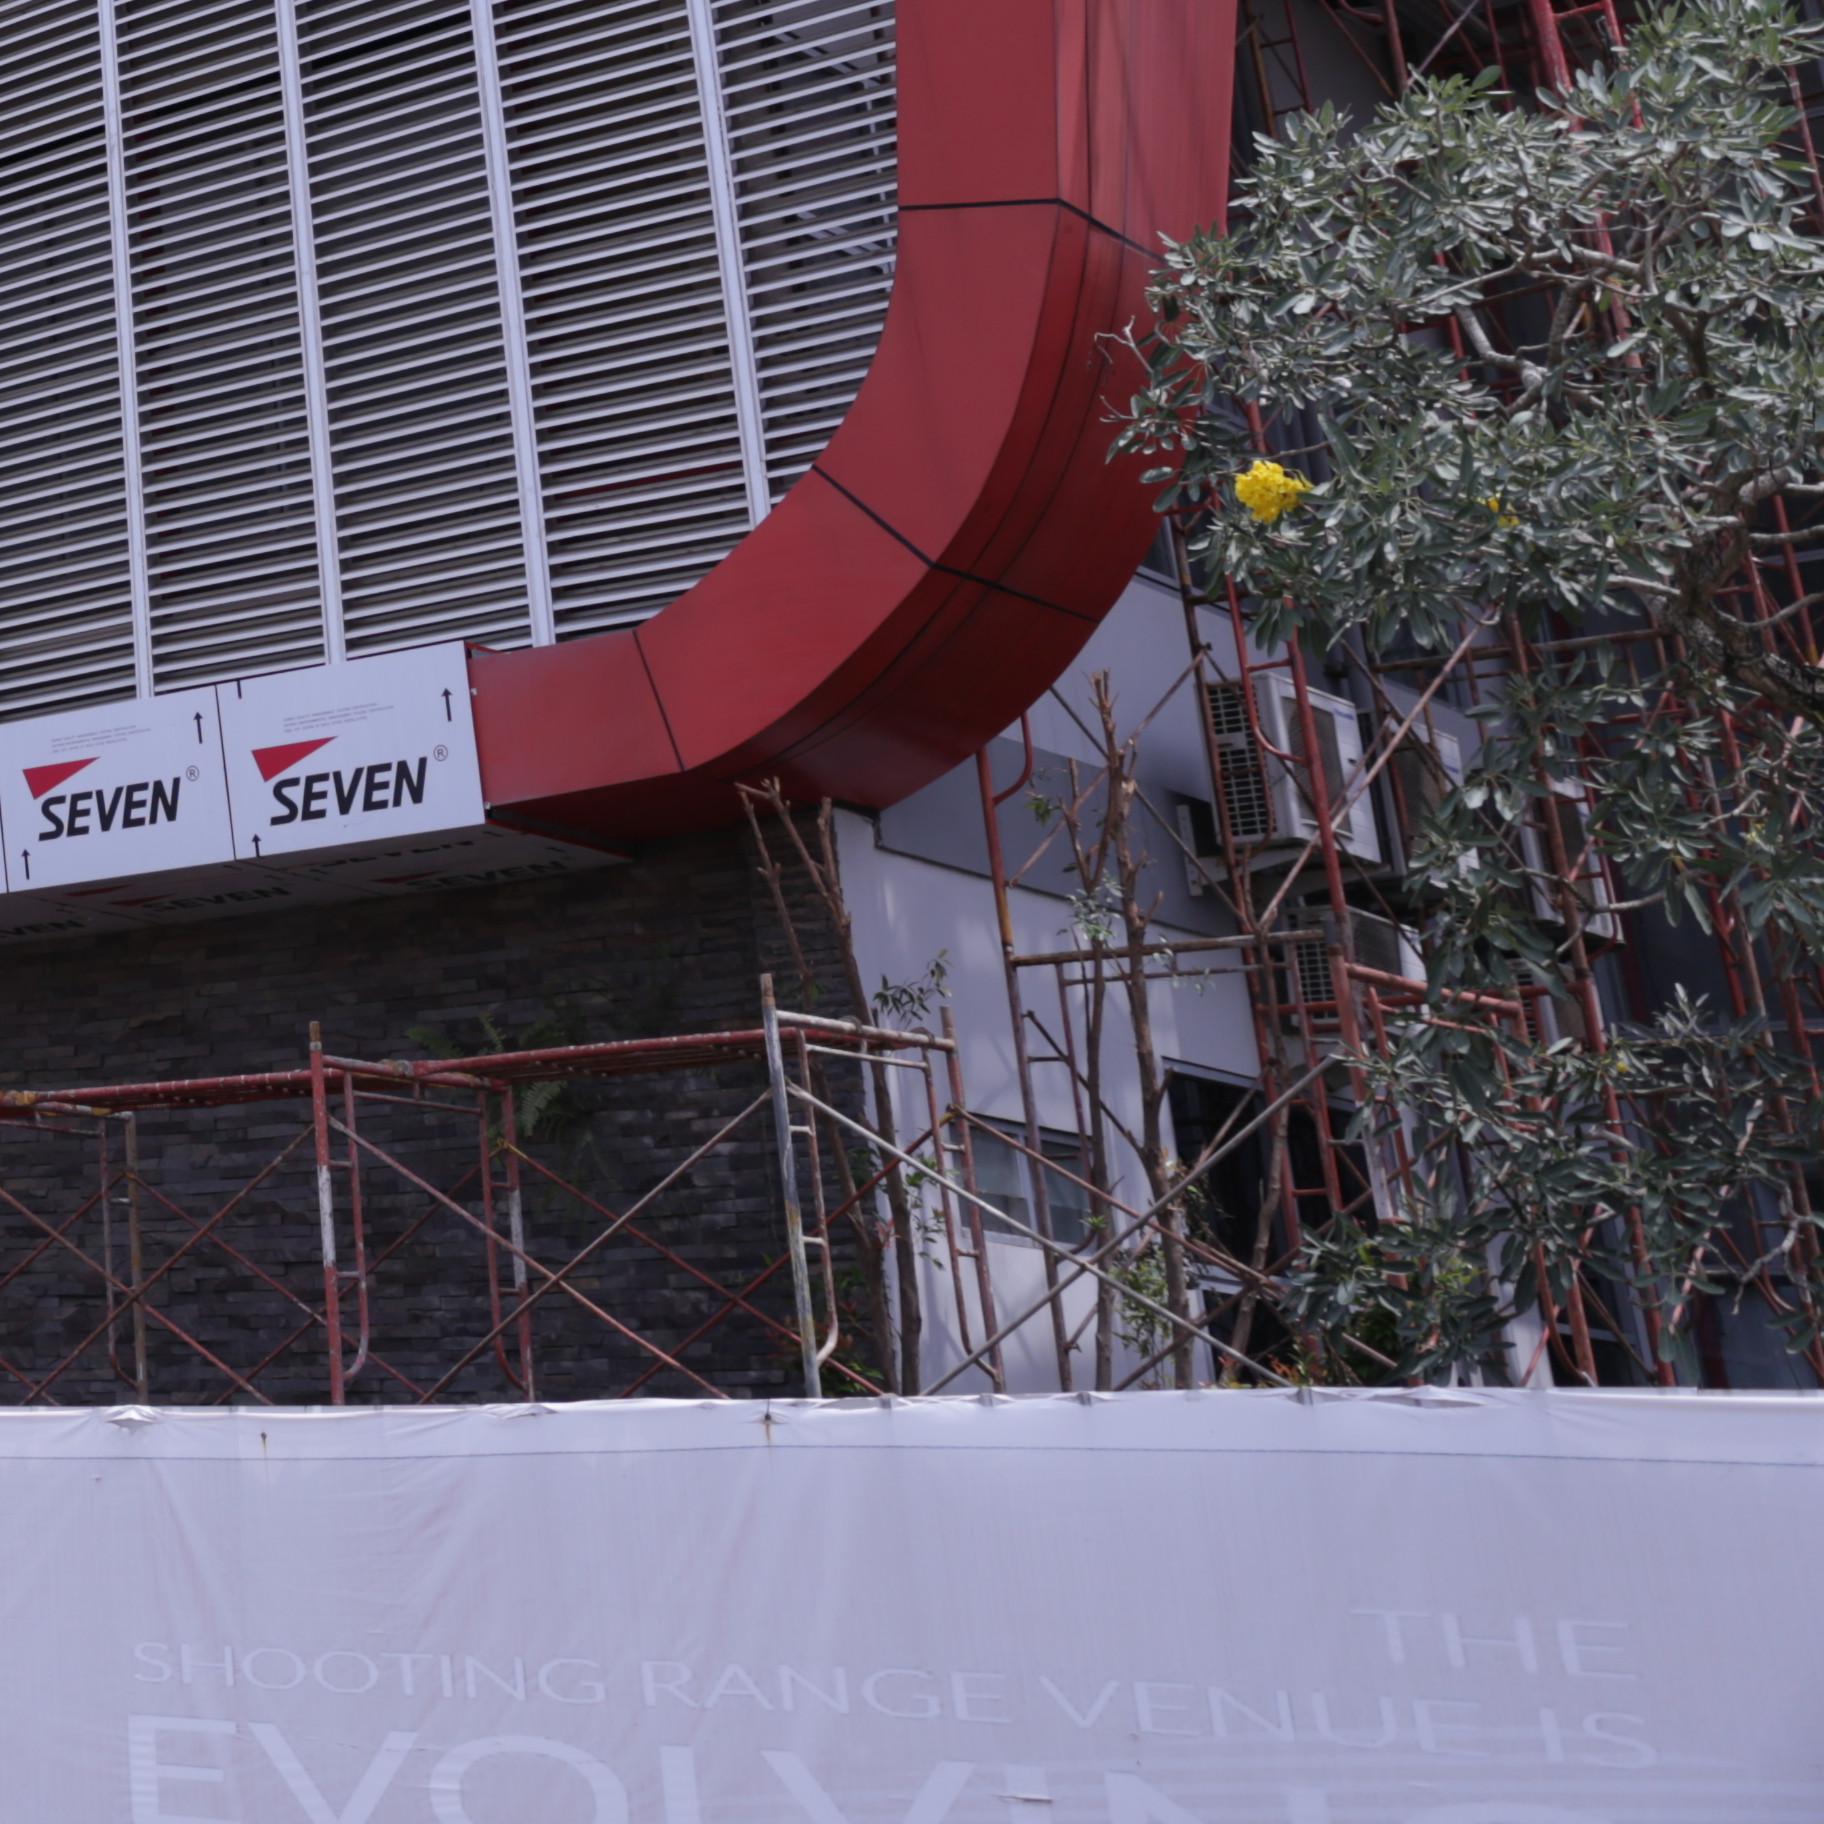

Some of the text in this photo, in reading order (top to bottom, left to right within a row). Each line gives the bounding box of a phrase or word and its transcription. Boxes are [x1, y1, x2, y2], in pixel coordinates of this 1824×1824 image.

[39, 777, 180, 841] SEVEN
[270, 757, 427, 826] SEVEN
[1350, 1608, 1642, 1681] THE
[132, 1641, 1656, 1771] SHOOTING RANGE VENUE IS
